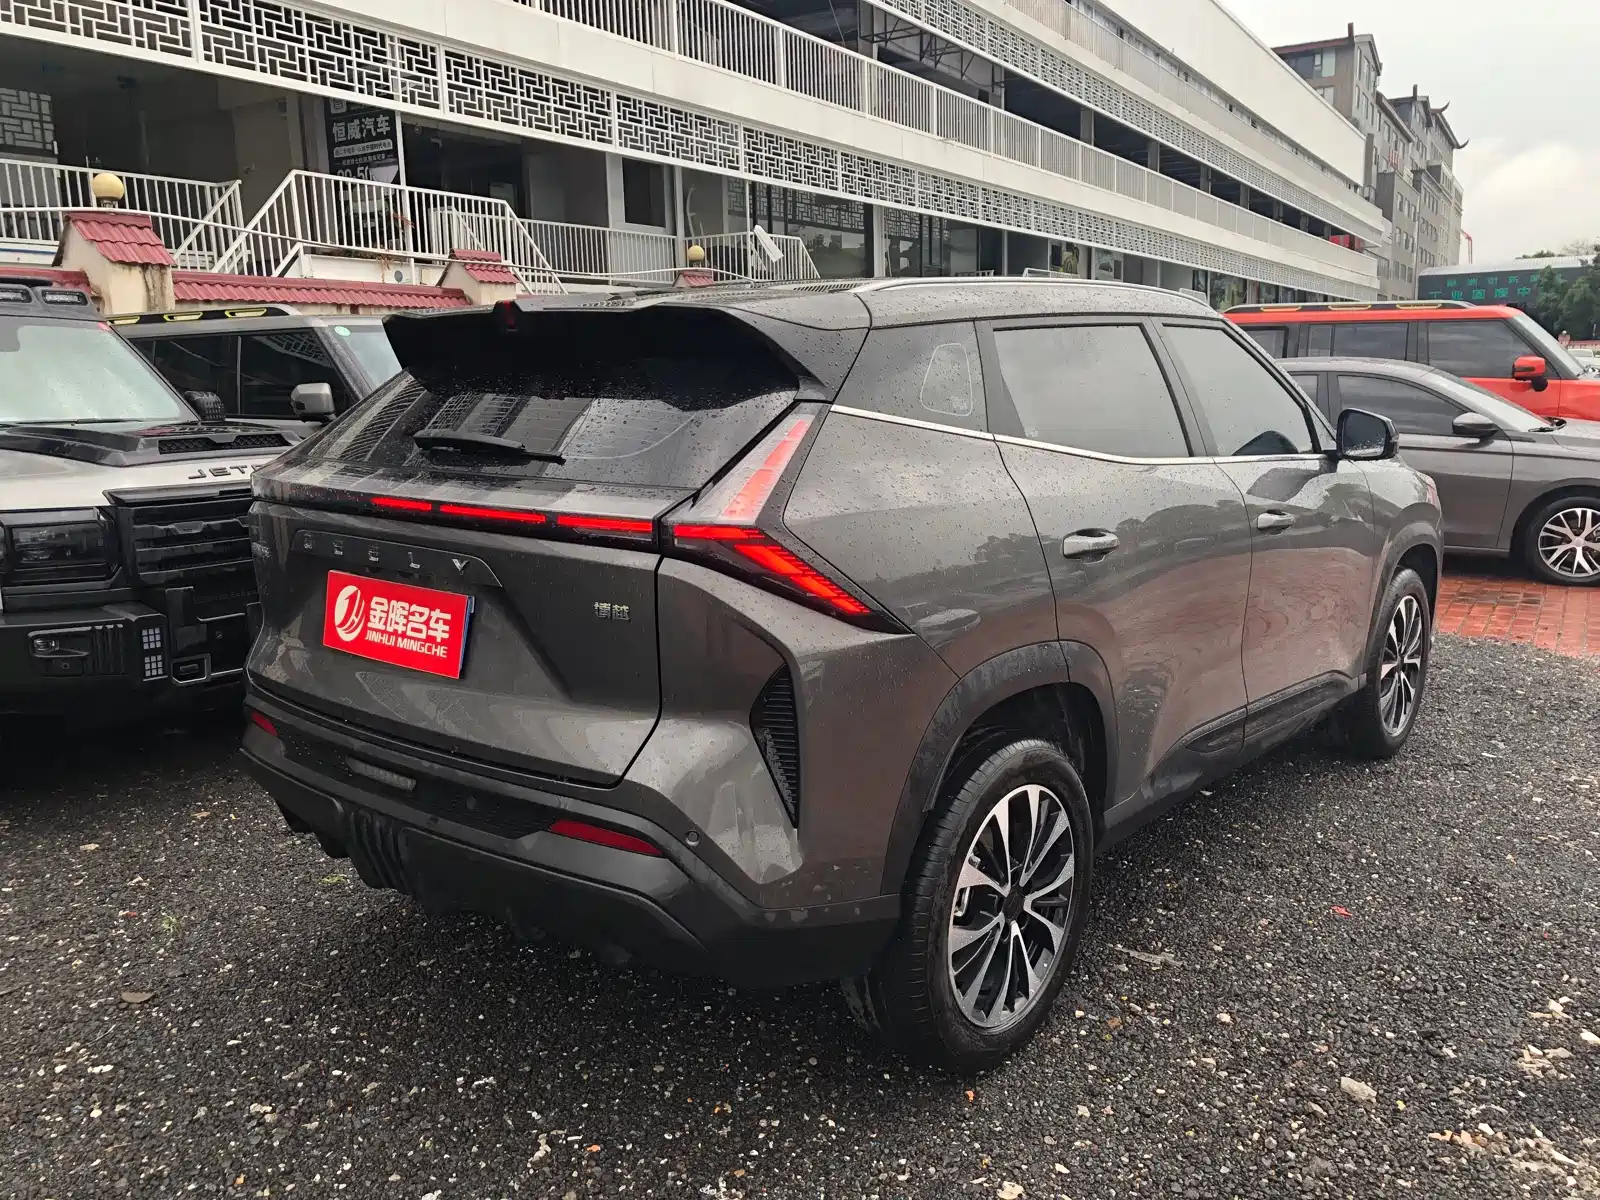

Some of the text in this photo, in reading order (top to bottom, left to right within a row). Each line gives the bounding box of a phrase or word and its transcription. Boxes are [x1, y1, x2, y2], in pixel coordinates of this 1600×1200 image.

[332, 114, 391, 143] 恒威汽车
[303, 532, 470, 576] GEELY
[367, 596, 452, 643] 金晖名车
[365, 629, 448, 658] JINHUI MINGCHE
